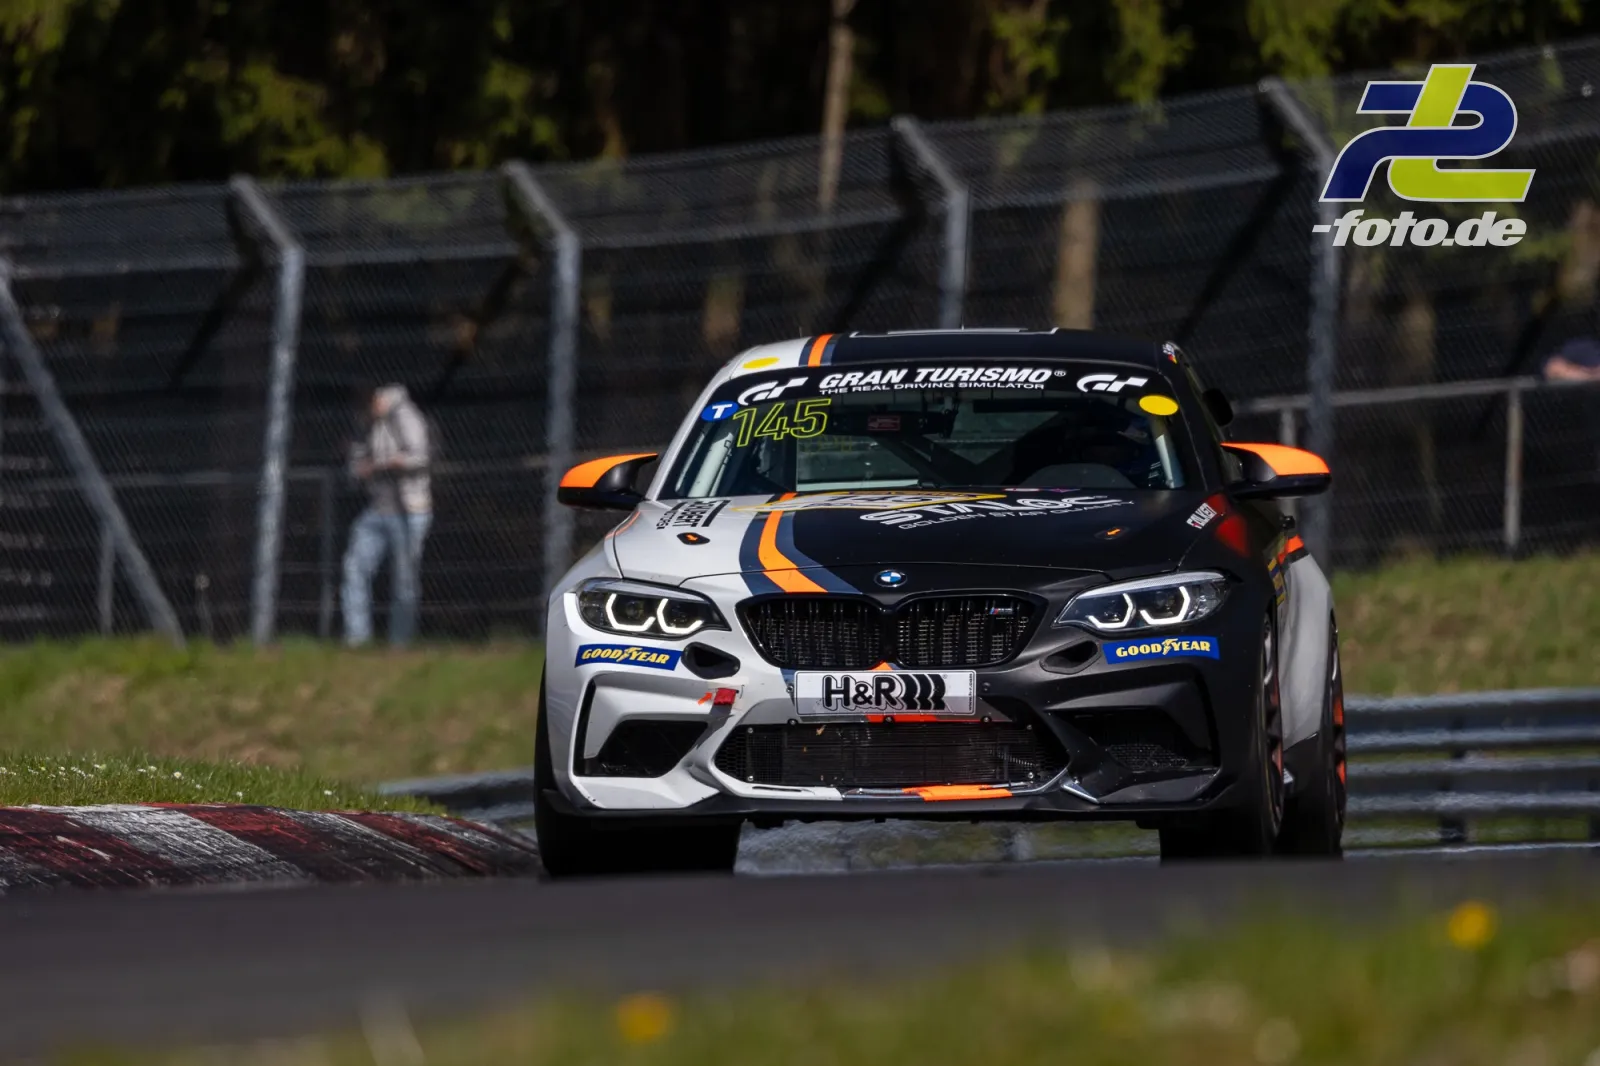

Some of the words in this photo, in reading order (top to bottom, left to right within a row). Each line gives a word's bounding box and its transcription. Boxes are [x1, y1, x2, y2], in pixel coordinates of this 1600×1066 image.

[818, 368, 909, 389] GRAN
[819, 388, 848, 396] THE
[894, 382, 955, 390] DRIVING
[958, 382, 1045, 390] SIMULATOR
[711, 404, 733, 419] T
[732, 398, 832, 448] 145
[898, 513, 987, 530] GOLDEN
[581, 647, 671, 665] GOODYEAR
[1115, 638, 1211, 658] GOODYEAR
[823, 674, 904, 711] H&R
